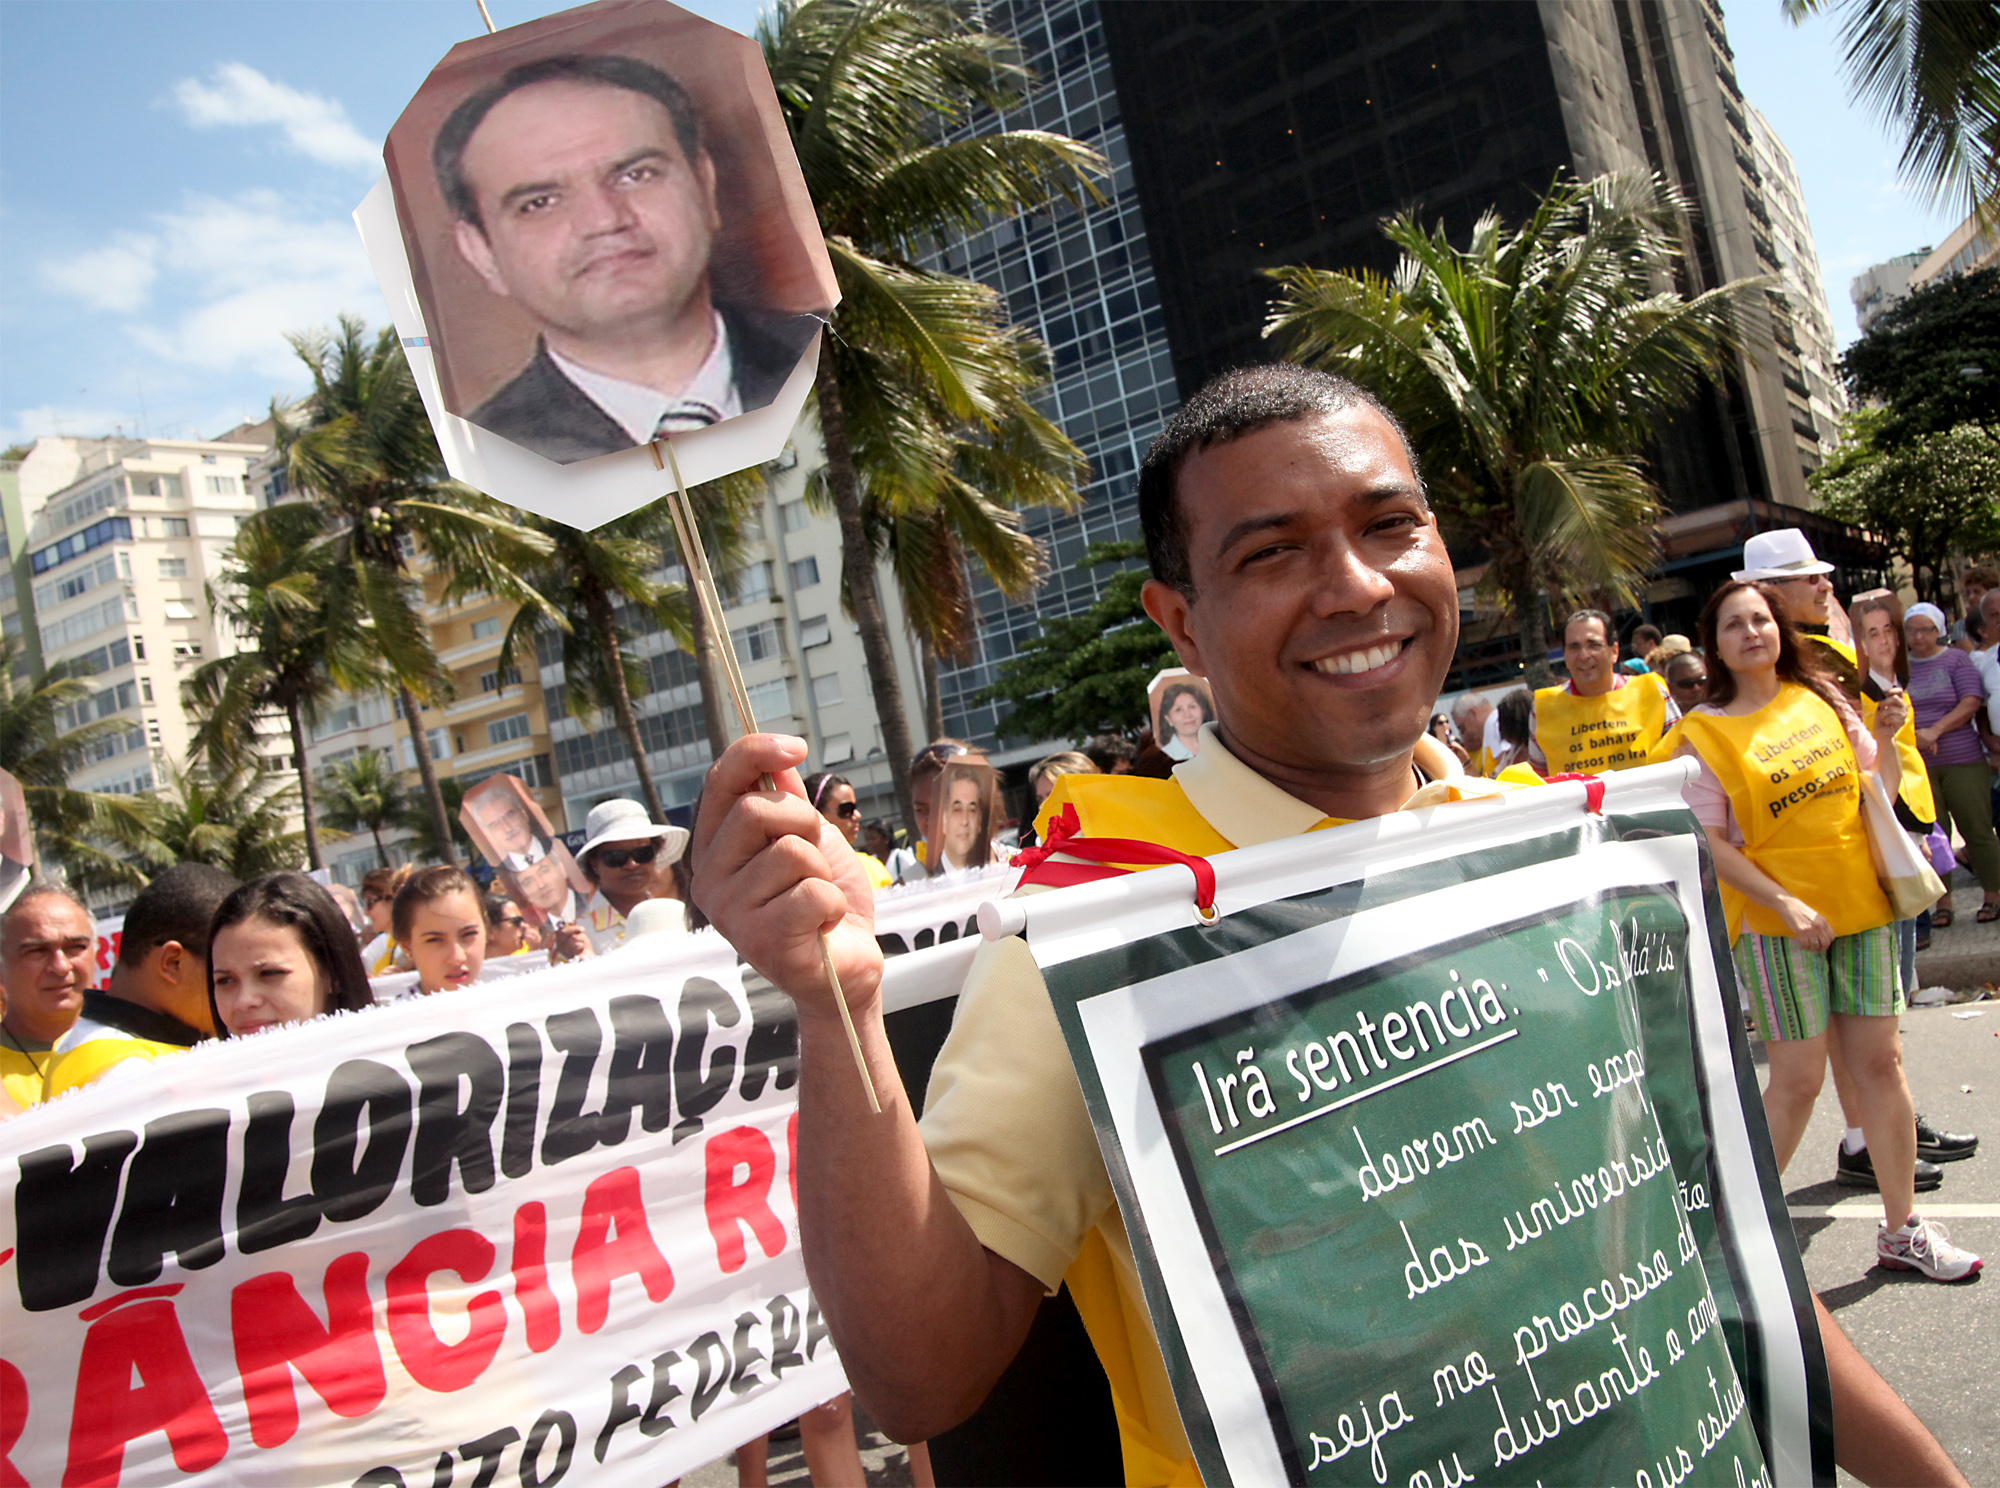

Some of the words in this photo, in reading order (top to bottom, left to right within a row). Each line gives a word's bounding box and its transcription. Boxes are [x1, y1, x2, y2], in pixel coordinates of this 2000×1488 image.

[1569, 743, 1583, 753] os
[1571, 720, 1627, 736] Libertem
[1608, 752, 1625, 763] no
[1754, 724, 1823, 764] Libertem
[1768, 777, 1825, 818] presos
[1825, 765, 1846, 782] no
[1770, 768, 1790, 784] os
[1192, 1046, 1276, 1136] Irã
[1287, 971, 1521, 1099] sentencia:
[1353, 1126, 1498, 1202] devem
[1511, 1081, 1579, 1134] ser
[1400, 1220, 1490, 1300] das
[0, 1166, 674, 1488] ÂNCIA
[1308, 1390, 1415, 1484] seja
[1434, 1351, 1496, 1408] no
[1513, 1248, 1674, 1402] processo
[1493, 1321, 1661, 1467] durante
